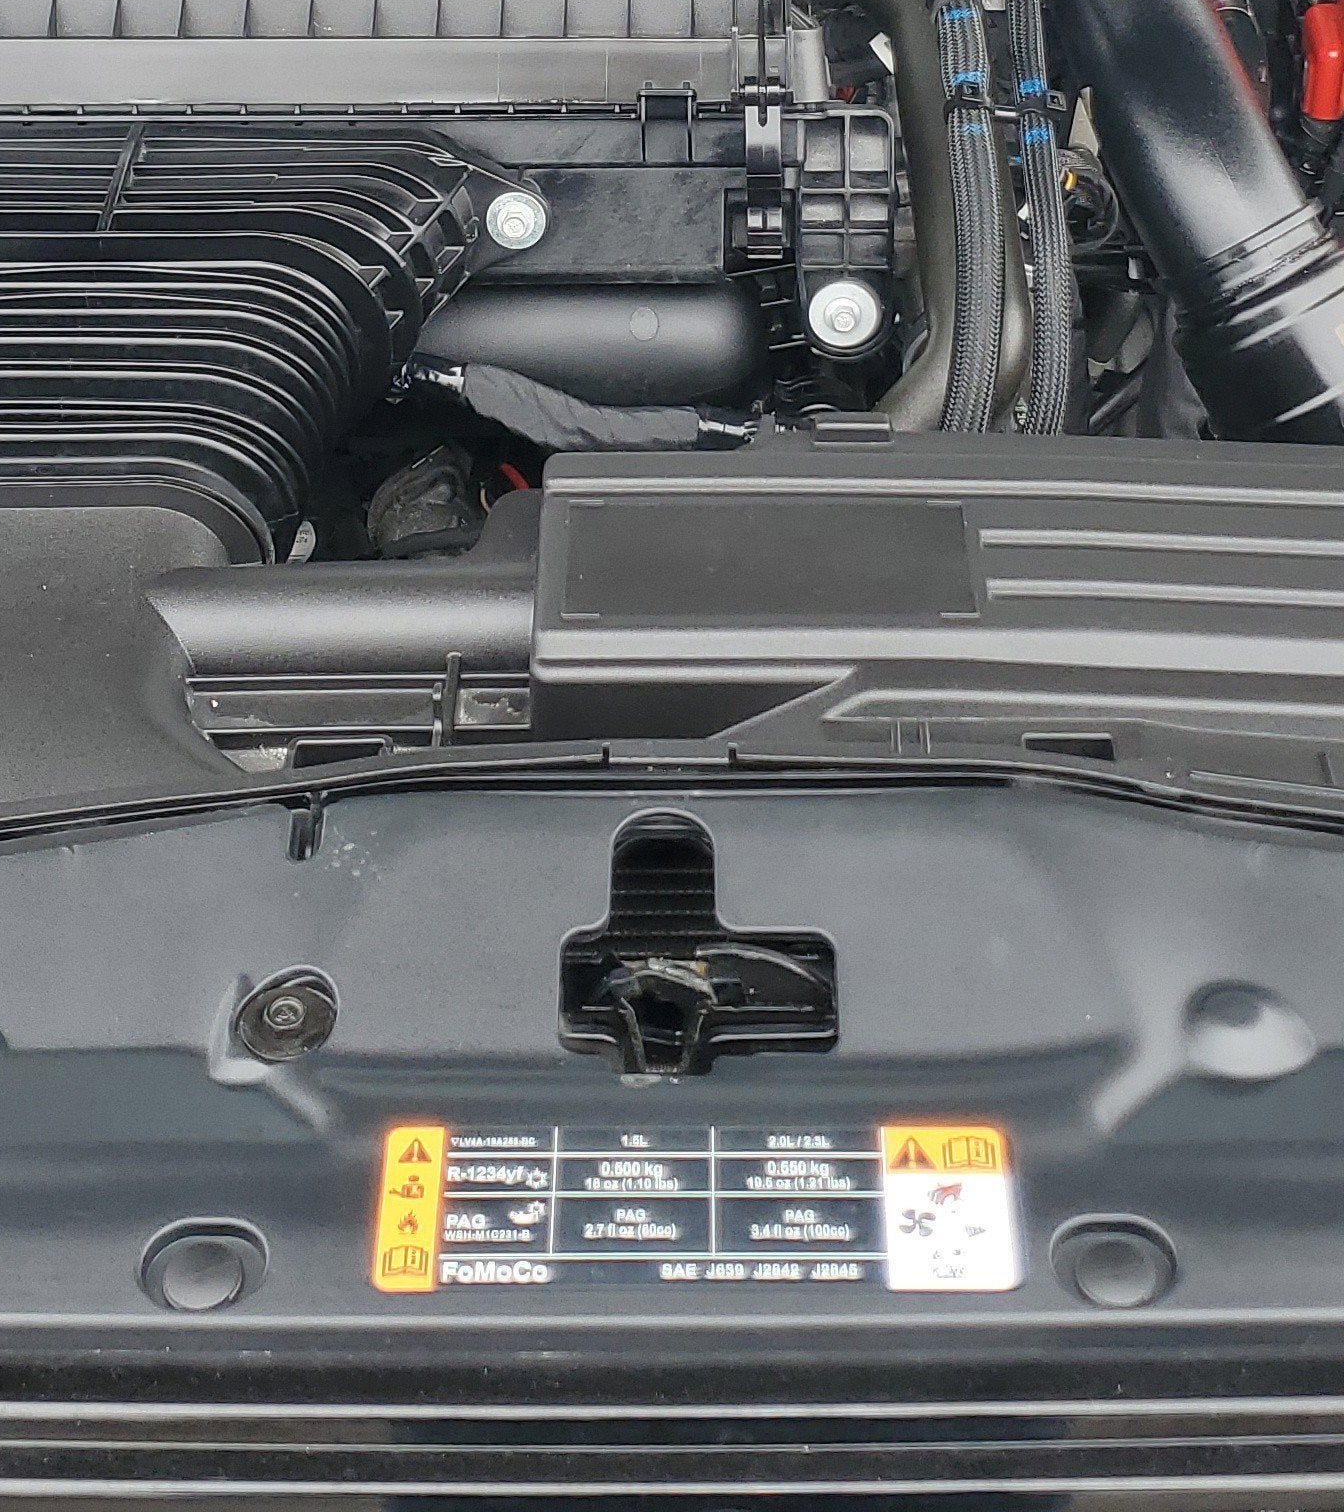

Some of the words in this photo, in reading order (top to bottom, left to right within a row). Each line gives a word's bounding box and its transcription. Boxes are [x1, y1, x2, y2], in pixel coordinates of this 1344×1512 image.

[447, 1165, 524, 1184] R-1234yf
[644, 1161, 663, 1178] kg
[810, 1160, 829, 1178] kg
[446, 1213, 487, 1229] PAG
[616, 1208, 646, 1221] PAG
[785, 1209, 815, 1222] PAG
[441, 1260, 549, 1282] FoMoCo
[661, 1262, 697, 1278] SAE
